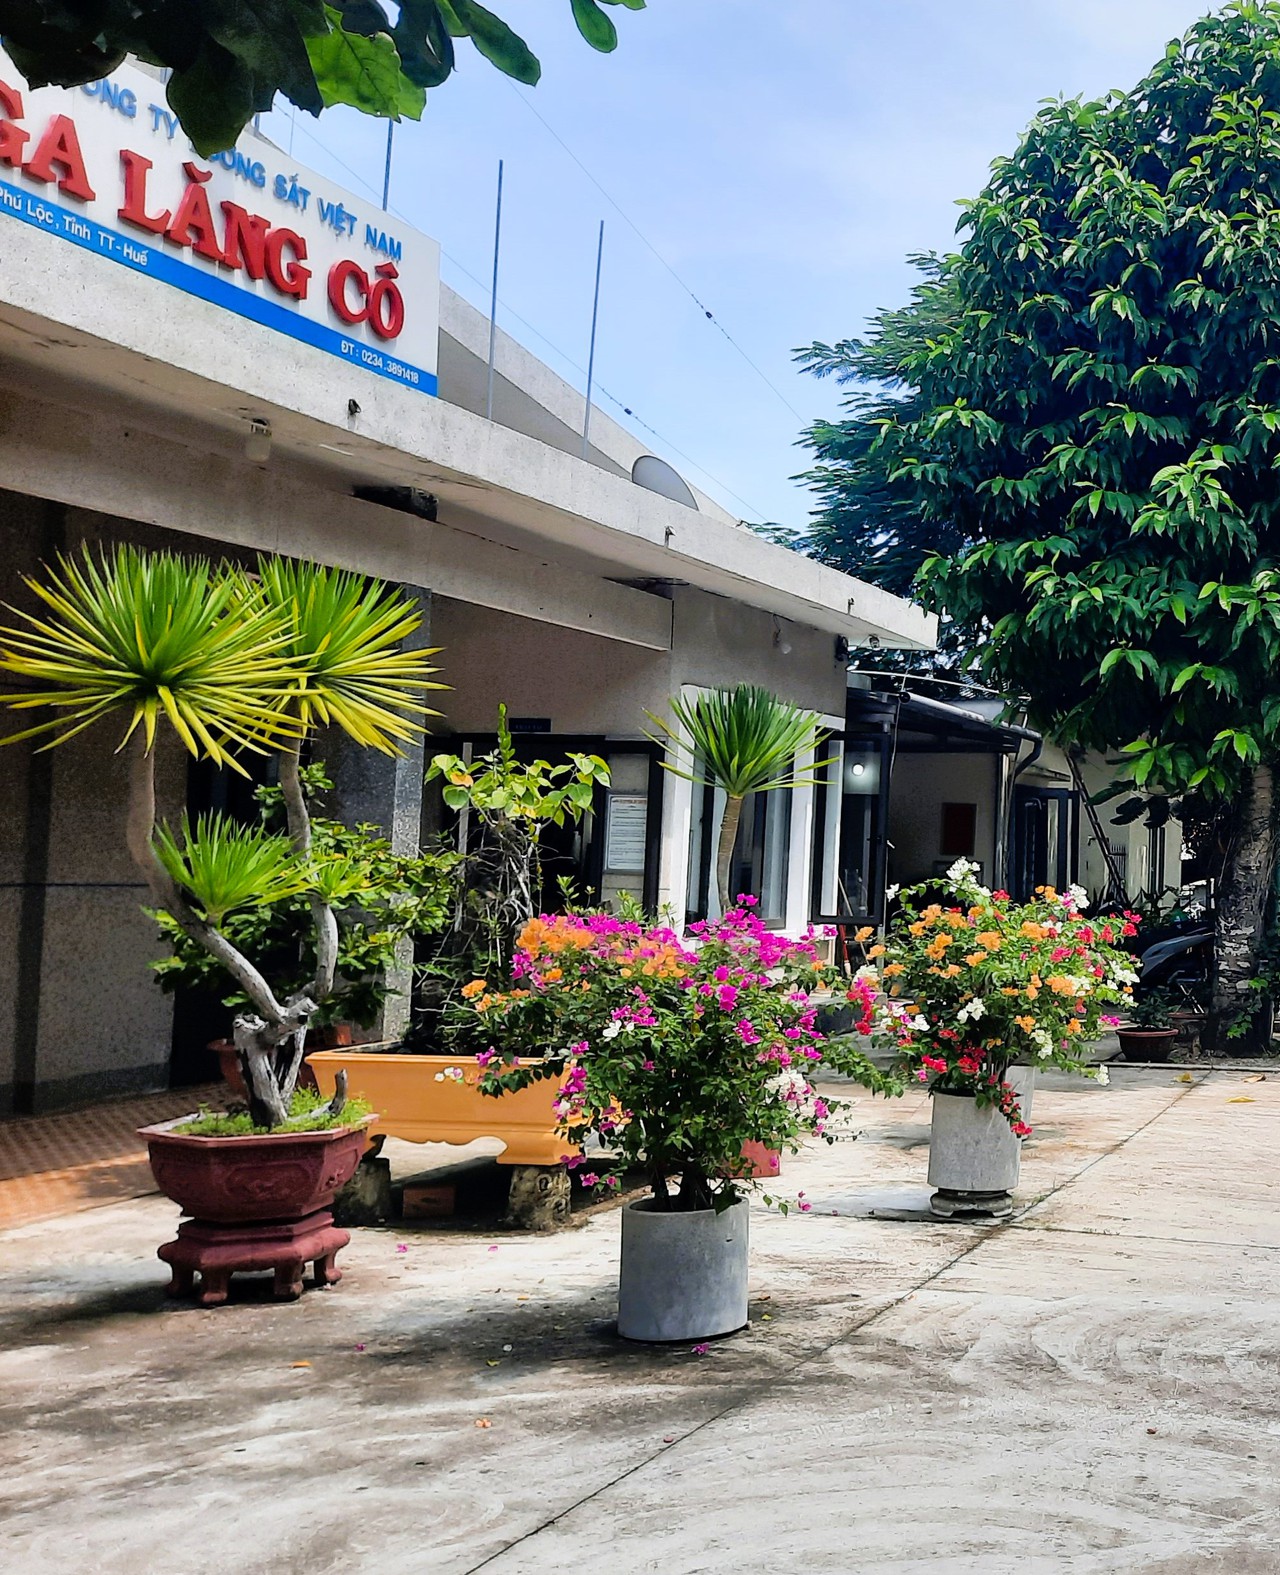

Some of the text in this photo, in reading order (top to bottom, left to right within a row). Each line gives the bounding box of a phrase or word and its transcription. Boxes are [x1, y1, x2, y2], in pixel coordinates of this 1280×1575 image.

[62, 214, 91, 241] Tỉnh
[118, 149, 312, 300] LĂNG
[327, 259, 405, 339] CÔ
[148, 103, 180, 139] TY
[273, 173, 311, 212] SẮT
[317, 197, 358, 237] VIỆT
[365, 224, 402, 262] NAM
